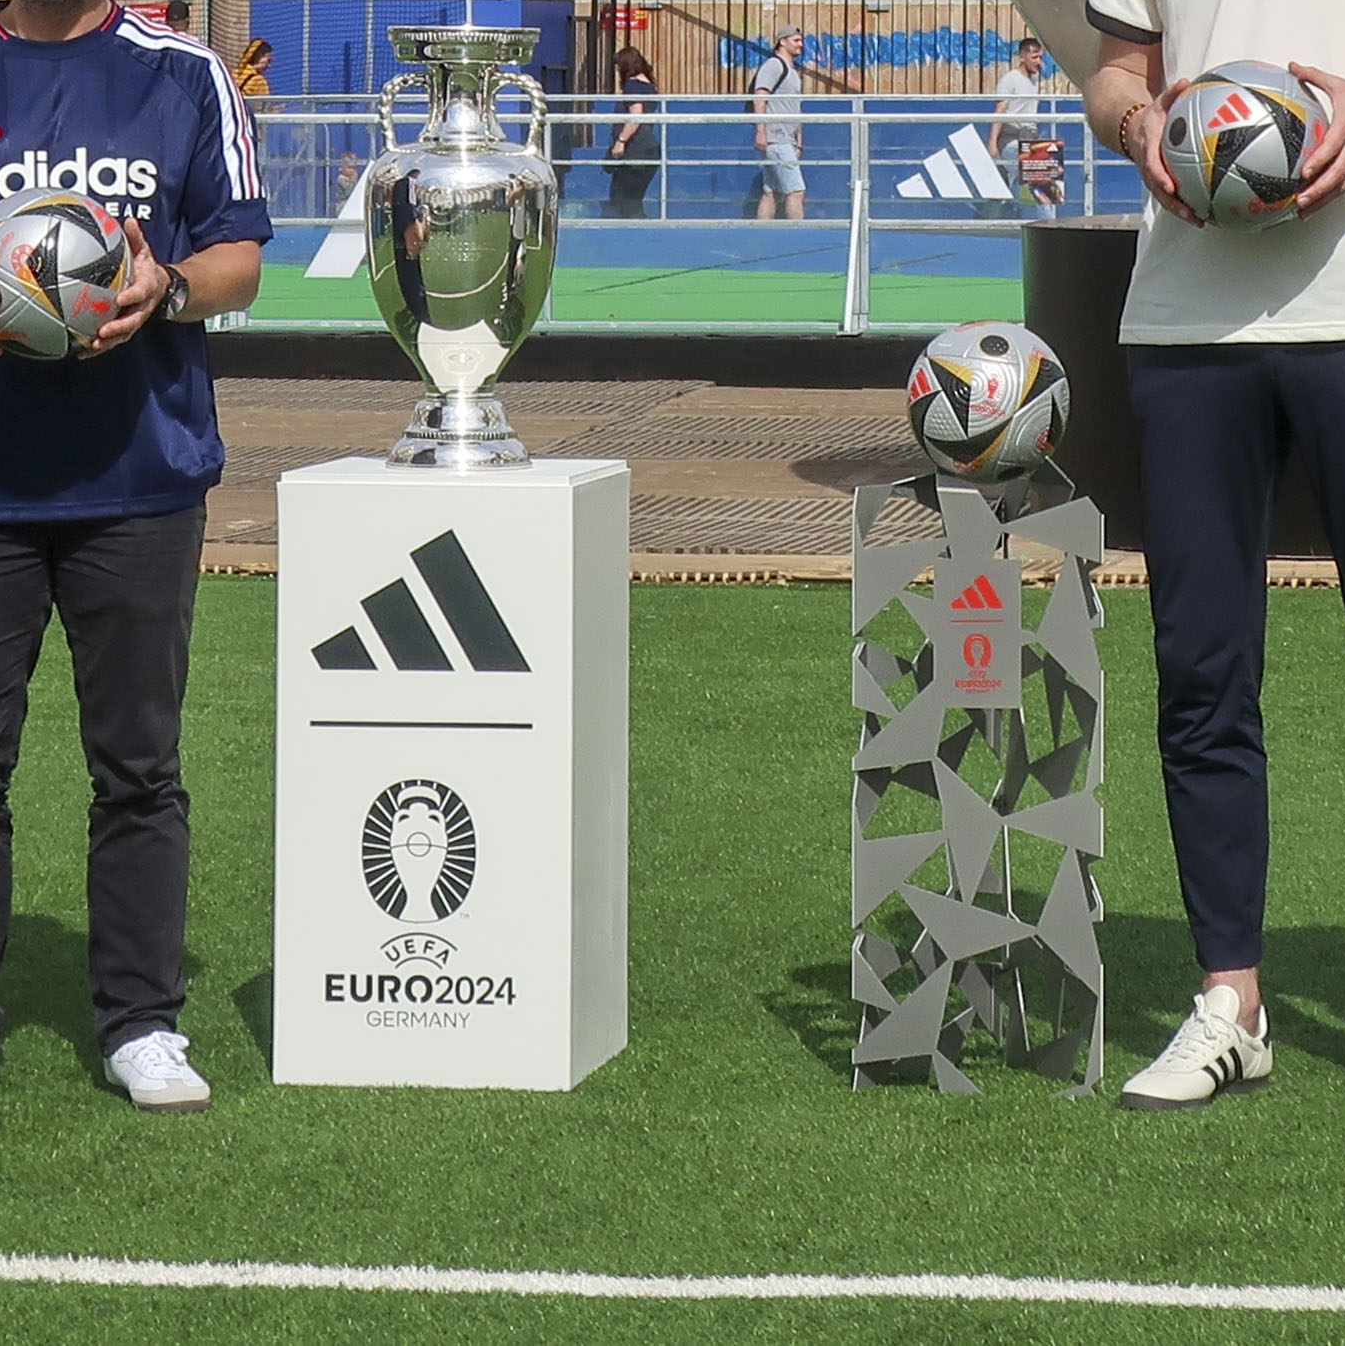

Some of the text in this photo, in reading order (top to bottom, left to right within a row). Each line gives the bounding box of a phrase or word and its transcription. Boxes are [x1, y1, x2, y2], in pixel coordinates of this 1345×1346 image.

[384, 938, 450, 965] UEFA
[324, 973, 516, 1006] EURO2024
[366, 1010, 471, 1028] GERMANY
